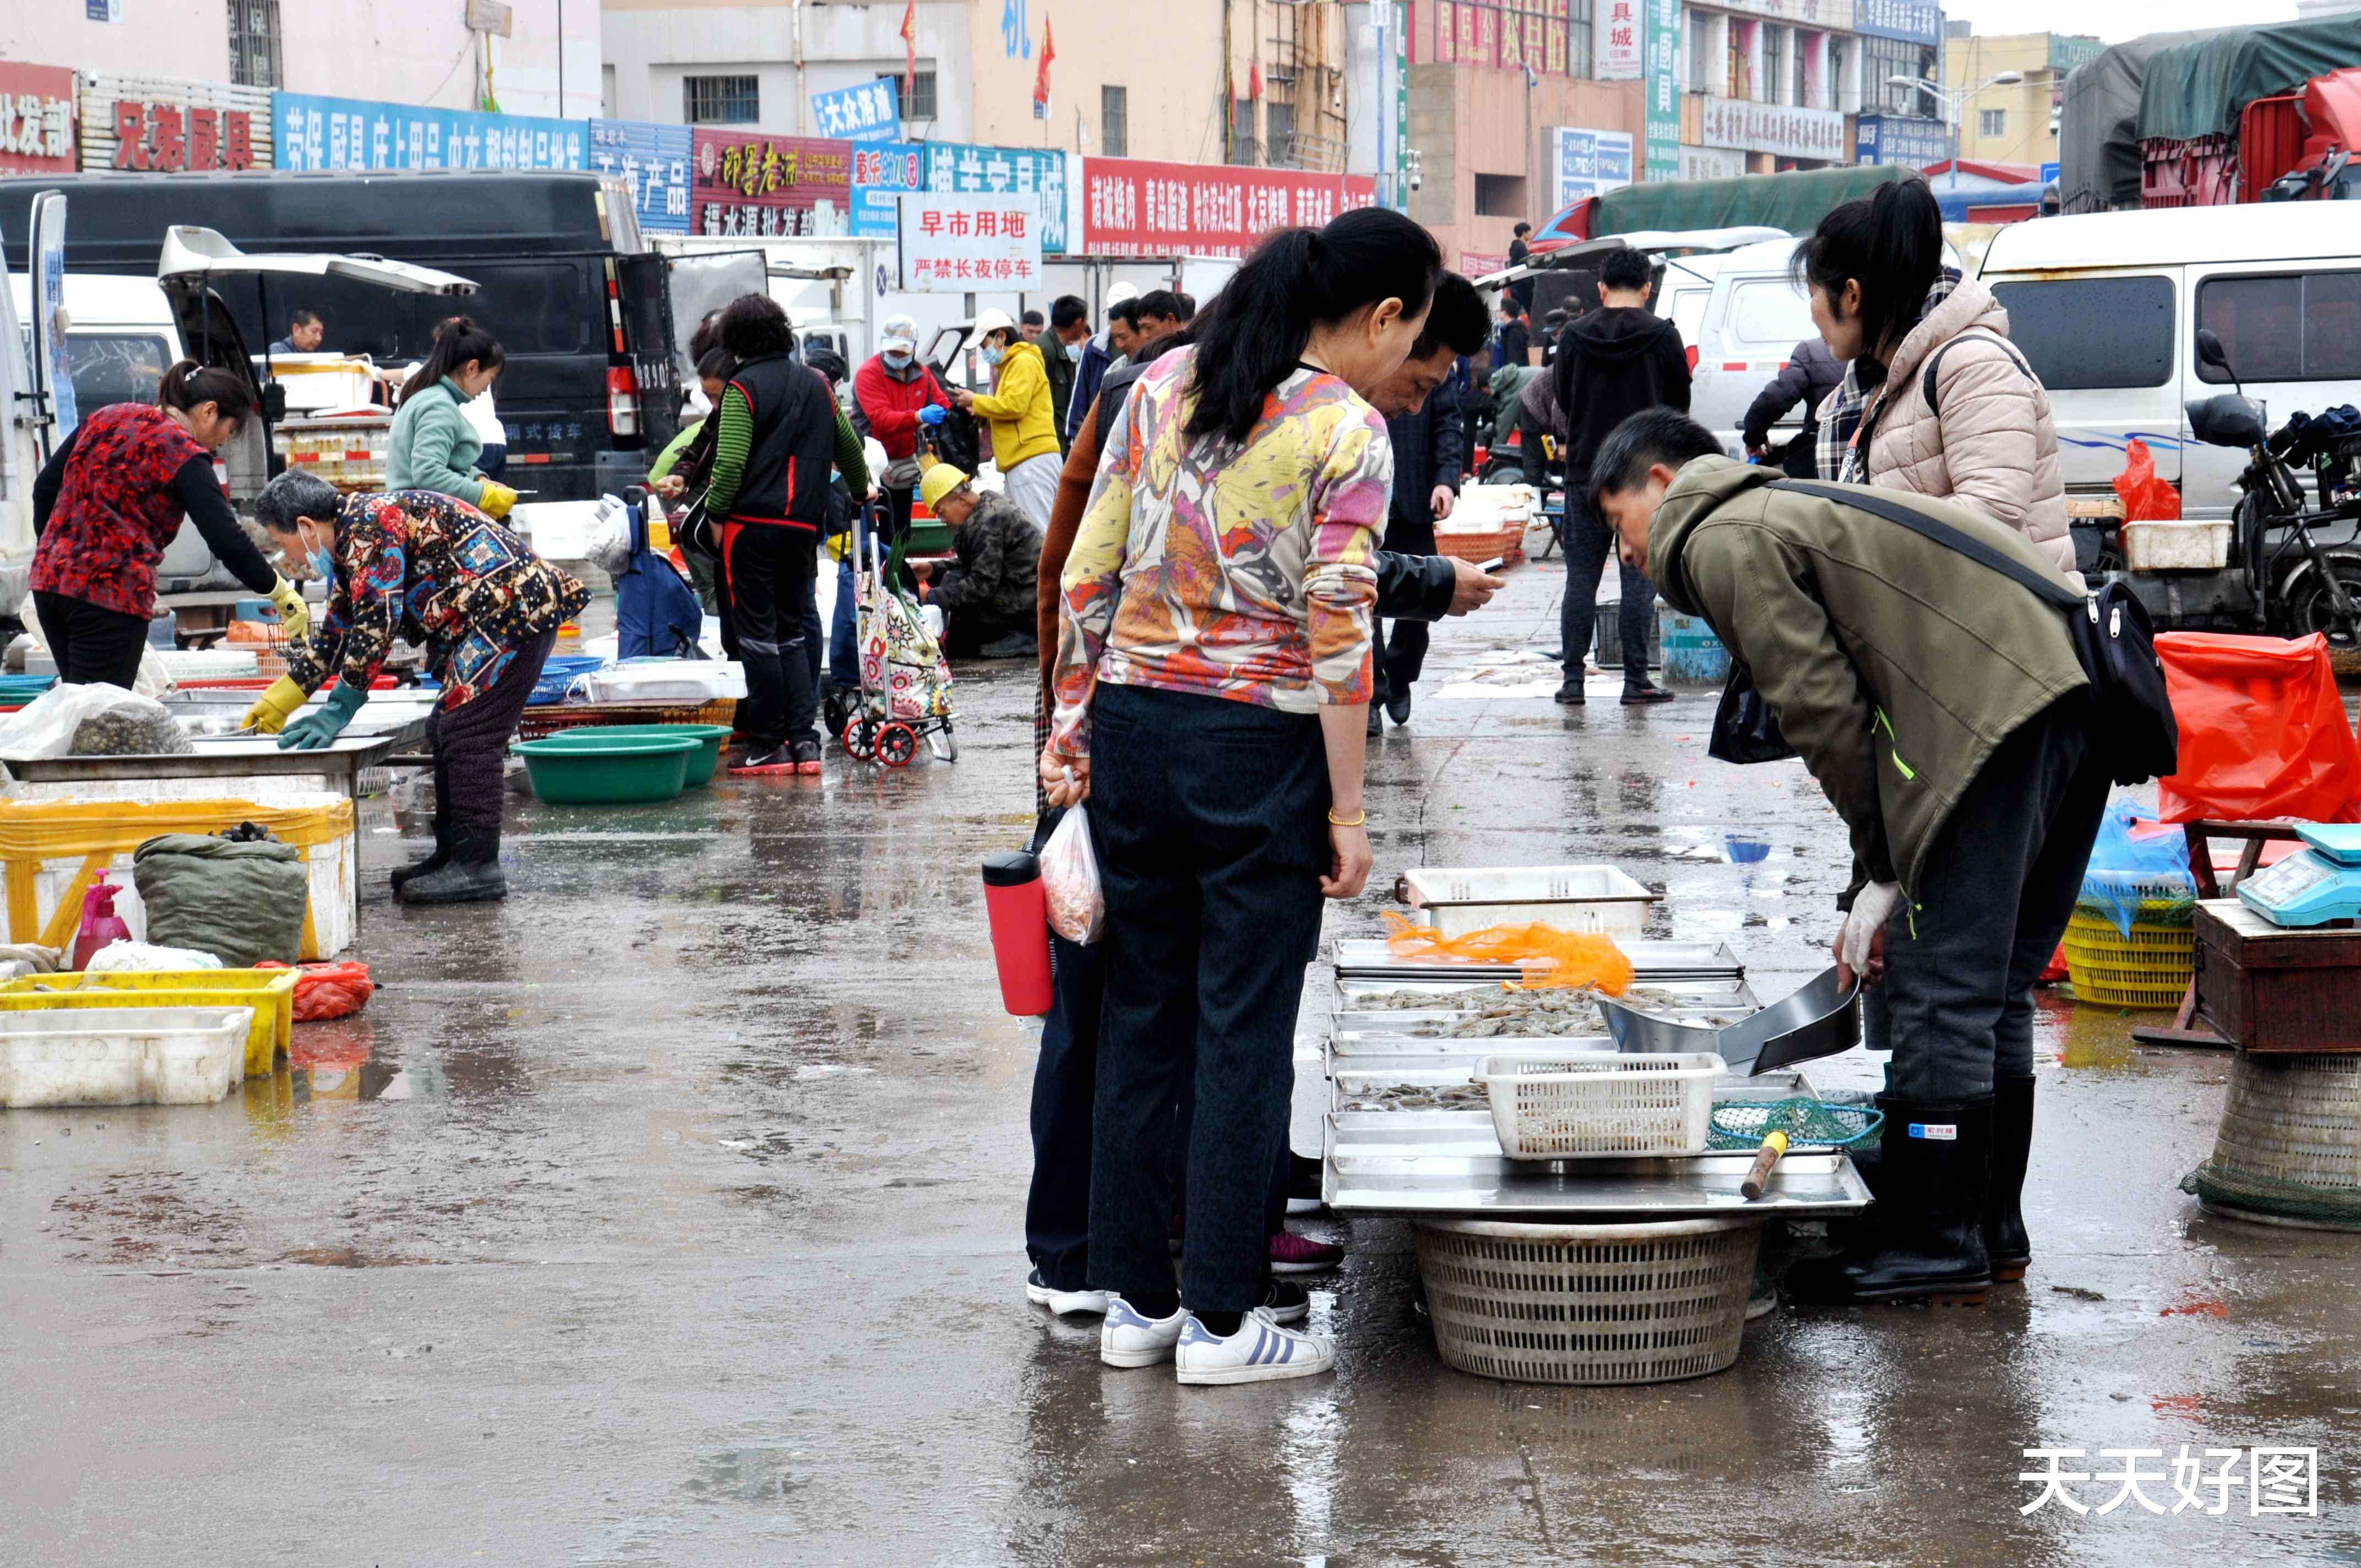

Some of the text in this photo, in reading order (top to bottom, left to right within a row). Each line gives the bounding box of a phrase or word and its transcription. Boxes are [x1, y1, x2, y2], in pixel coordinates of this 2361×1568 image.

[112, 101, 253, 171] 兄弟厨具
[855, 150, 918, 190] 童乐幼儿园
[919, 210, 1026, 238] 早市用地
[913, 257, 1033, 280] 严禁长夜停车
